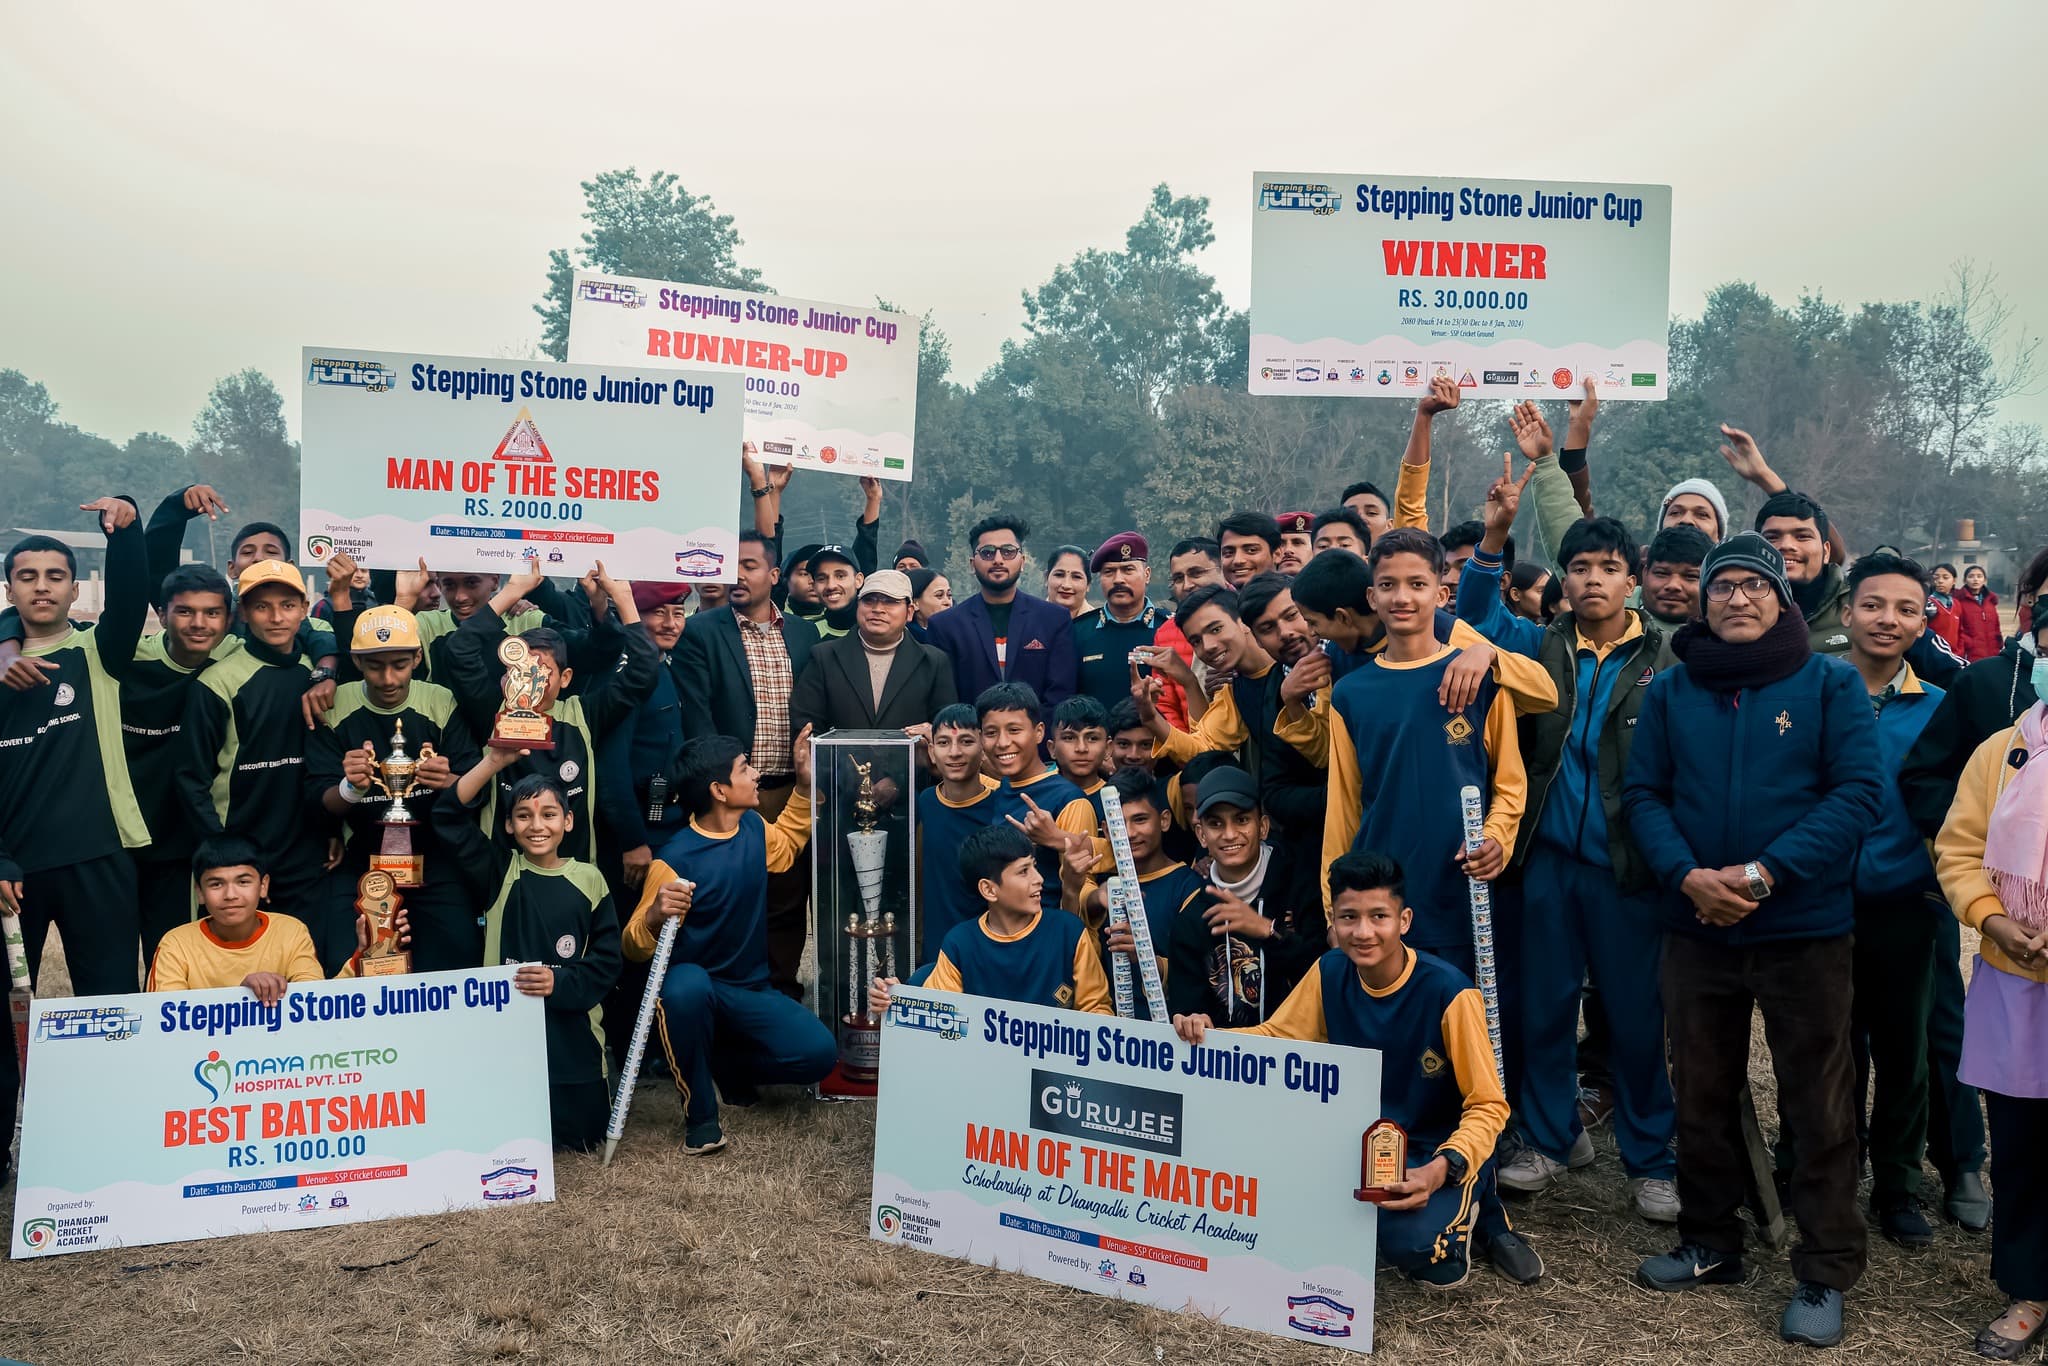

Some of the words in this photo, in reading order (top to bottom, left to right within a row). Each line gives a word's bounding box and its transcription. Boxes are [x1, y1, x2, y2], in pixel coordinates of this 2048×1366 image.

[1263, 183, 1302, 193] Stepping
[1306, 184, 1334, 192] Ston
[1259, 191, 1342, 211] junior
[1356, 184, 1454, 221] Stepping
[1459, 187, 1522, 217] Stone
[1528, 191, 1598, 219] Junior
[1604, 193, 1642, 227] Cup
[1313, 207, 1335, 215] CUP
[1382, 240, 1546, 280] WINNER
[1399, 289, 1427, 308] RS.
[1434, 289, 1528, 310] 30,000.00
[659, 288, 741, 323] Stepping
[746, 299, 799, 327] Stone
[803, 307, 861, 335] Junior
[865, 316, 898, 345] Cup
[1470, 319, 1480, 327] Dec
[1482, 319, 1488, 327] to
[648, 328, 848, 379] RUNNER-UP
[311, 358, 355, 369] Stepping
[308, 367, 396, 385] junior
[366, 383, 389, 393] CUP
[411, 363, 514, 403] Stepping
[520, 370, 587, 401] Stone
[593, 375, 668, 405] Junior
[673, 379, 714, 414] Cup
[746, 377, 800, 397] 000.00
[387, 457, 454, 492] MAN
[461, 461, 496, 494] OF
[504, 464, 557, 497] THE
[564, 467, 660, 502] SERIES
[464, 498, 494, 517] RS.
[501, 500, 583, 521] 2000.00
[325, 524, 353, 533] Organized
[456, 528, 470, 537] 14th
[471, 528, 489, 538] Paush
[490, 529, 506, 538] 2080
[334, 538, 373, 548] DHANGADHI
[552, 532, 564, 541] SSP
[565, 533, 586, 542] Cricket
[586, 534, 609, 543] Ground
[334, 547, 361, 555] CRICKET
[476, 548, 505, 557] Powered
[361, 616, 408, 636] RAIDERS
[0, 738, 23, 748] COVERY
[160, 996, 282, 1037] Stepping
[289, 991, 366, 1023] Stone
[373, 982, 457, 1016] Junior
[464, 978, 511, 1012] Cup
[891, 995, 930, 1011] Stepping
[41, 1009, 93, 1021] Stepping
[885, 1004, 969, 1032] junior
[34, 1014, 142, 1043] junior
[940, 1030, 962, 1041] CUP
[105, 1032, 133, 1042] CUP
[235, 1055, 305, 1077] MAYA
[310, 1047, 398, 1071] METRO
[983, 1007, 1091, 1067] Stepping
[1097, 1026, 1174, 1072] Stone
[1181, 1043, 1276, 1086] Junior
[1284, 1052, 1340, 1104] Cup
[235, 1077, 302, 1094] HOSPITAL
[306, 1074, 335, 1088] PVT.
[338, 1072, 363, 1085] LTD
[164, 1104, 252, 1148] BEST
[261, 1088, 426, 1139] BATSMAN
[1041, 1085, 1174, 1137] GURUJEE
[228, 1145, 265, 1168] RS.
[274, 1134, 366, 1164] 1000.00
[335, 1172, 349, 1183] SSP
[349, 1170, 374, 1182] Cricket
[374, 1167, 401, 1179] Ground
[965, 1122, 1030, 1172] MAN
[1037, 1138, 1072, 1179] OF
[1080, 1146, 1136, 1194] THE
[1144, 1158, 1258, 1218] MATCH
[215, 1183, 233, 1194] 14th
[234, 1181, 257, 1193] Paush
[258, 1179, 277, 1190] 2080
[47, 1200, 83, 1212] Organized
[84, 1199, 96, 1209] by:
[894, 1193, 922, 1206] Organized
[962, 1164, 1033, 1202] Scholarship
[1037, 1185, 1054, 1202] at
[1058, 1184, 1130, 1219] Dhangadhi
[1135, 1201, 1191, 1232] Cricket
[1192, 1213, 1258, 1250] Academy
[241, 1203, 277, 1215] Powered
[277, 1202, 291, 1213] by:
[58, 1215, 109, 1228] DHANGADHI
[902, 1212, 941, 1229] DHANGADHI
[57, 1226, 93, 1238] CRICKET
[902, 1222, 929, 1236] CRICKET
[1026, 1219, 1042, 1232] 14th
[1042, 1223, 1062, 1238] Paush
[1063, 1229, 1080, 1242] 2080
[56, 1235, 99, 1247] ACADEMY
[901, 1232, 933, 1246] ACADEMY
[1048, 1251, 1079, 1268] Powered
[1080, 1259, 1092, 1272] by:
[1134, 1244, 1148, 1256] SSP
[1148, 1248, 1173, 1262] Cricket
[1173, 1253, 1201, 1269] Ground
[1302, 1281, 1317, 1291] Title
[1317, 1284, 1344, 1297] Sponsor:
